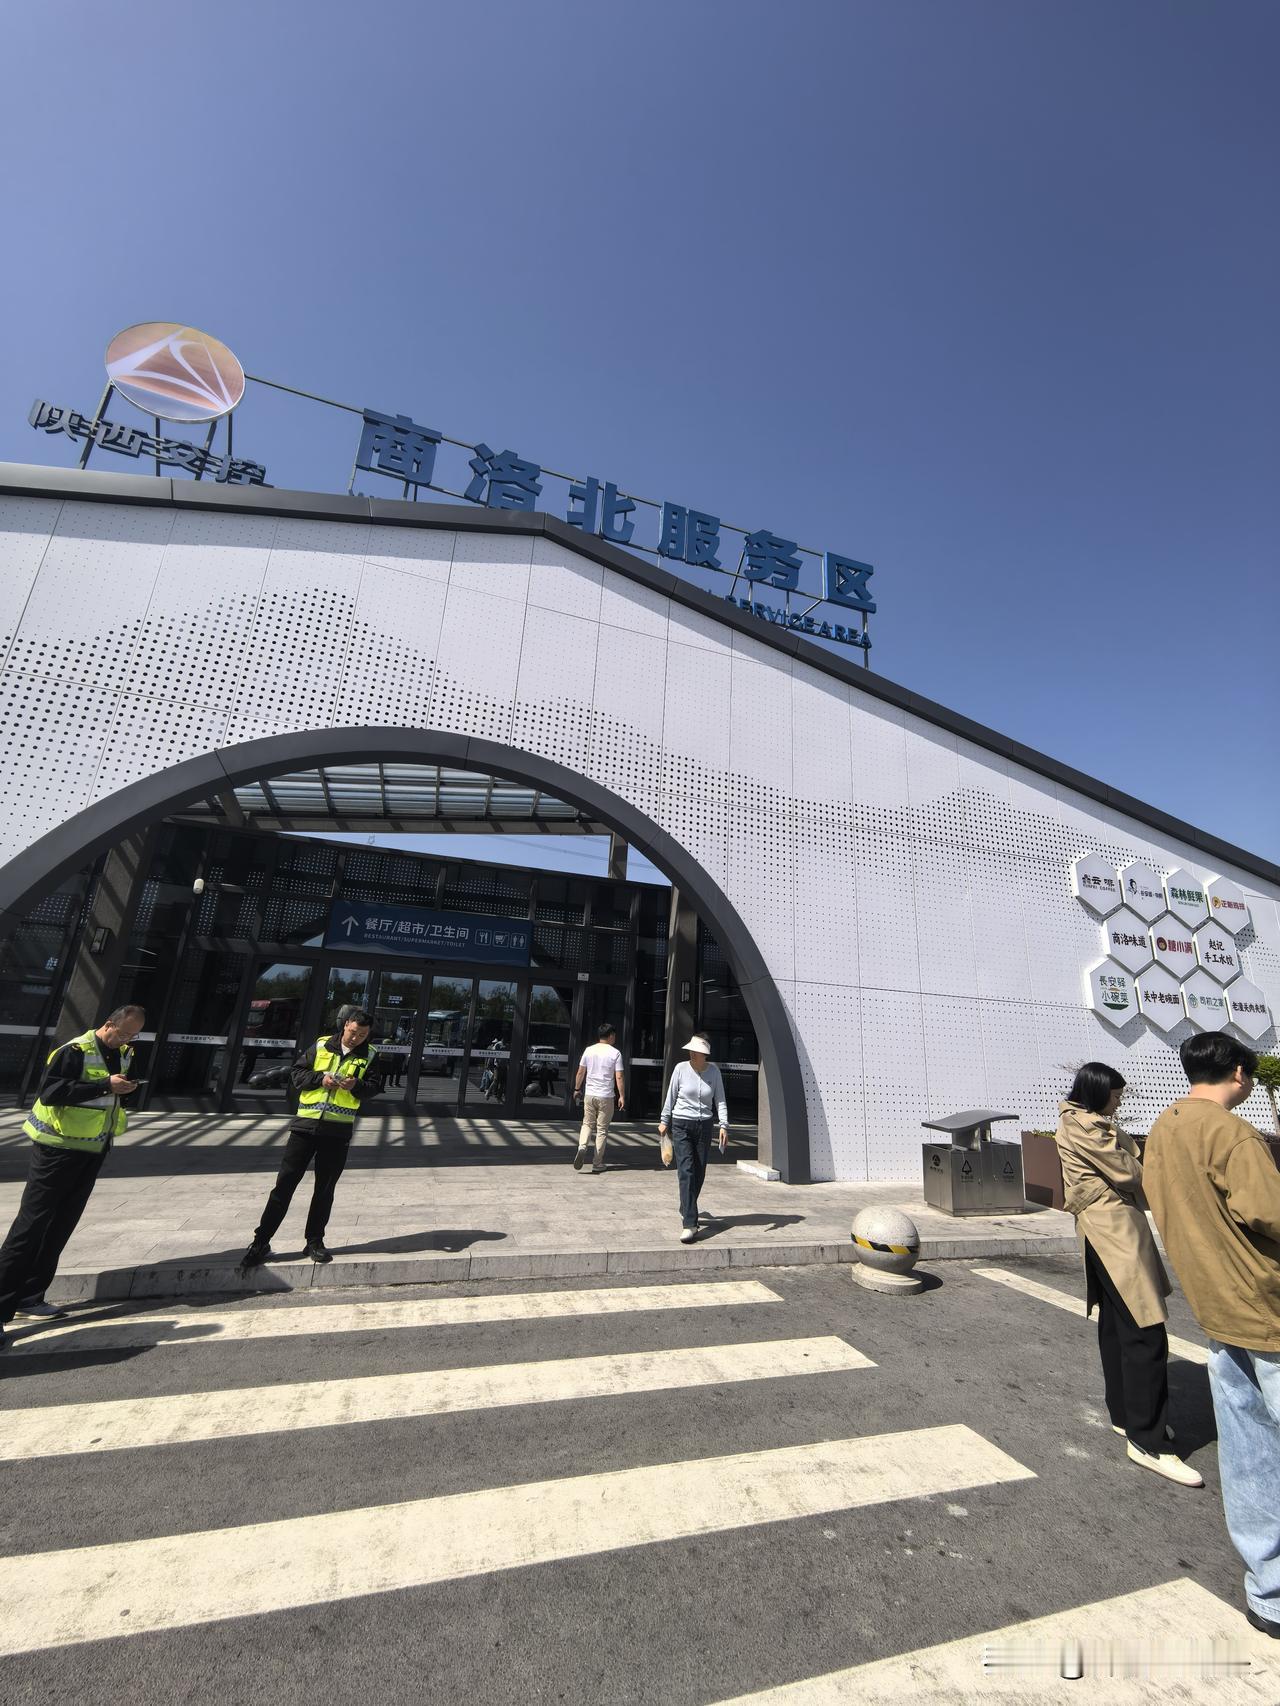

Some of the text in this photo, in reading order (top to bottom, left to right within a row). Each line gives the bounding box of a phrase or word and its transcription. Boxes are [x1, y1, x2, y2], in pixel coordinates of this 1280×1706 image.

[356, 408, 877, 614] 商洛北服务区
[818, 621, 872, 648] AREA
[1170, 887, 1204, 903] 森林鲜果
[365, 917, 469, 940] 餐厅/超市/卫生间
[364, 933, 466, 948] RESTAURANT/SUPERMARKET/TOILET
[1112, 931, 1147, 948] 商洛味道
[1208, 938, 1225, 951] 赵记
[1204, 952, 1234, 966] 手工水饺
[1101, 990, 1129, 1003] 小碗菜
[1144, 990, 1180, 1004] 关中老碗面
